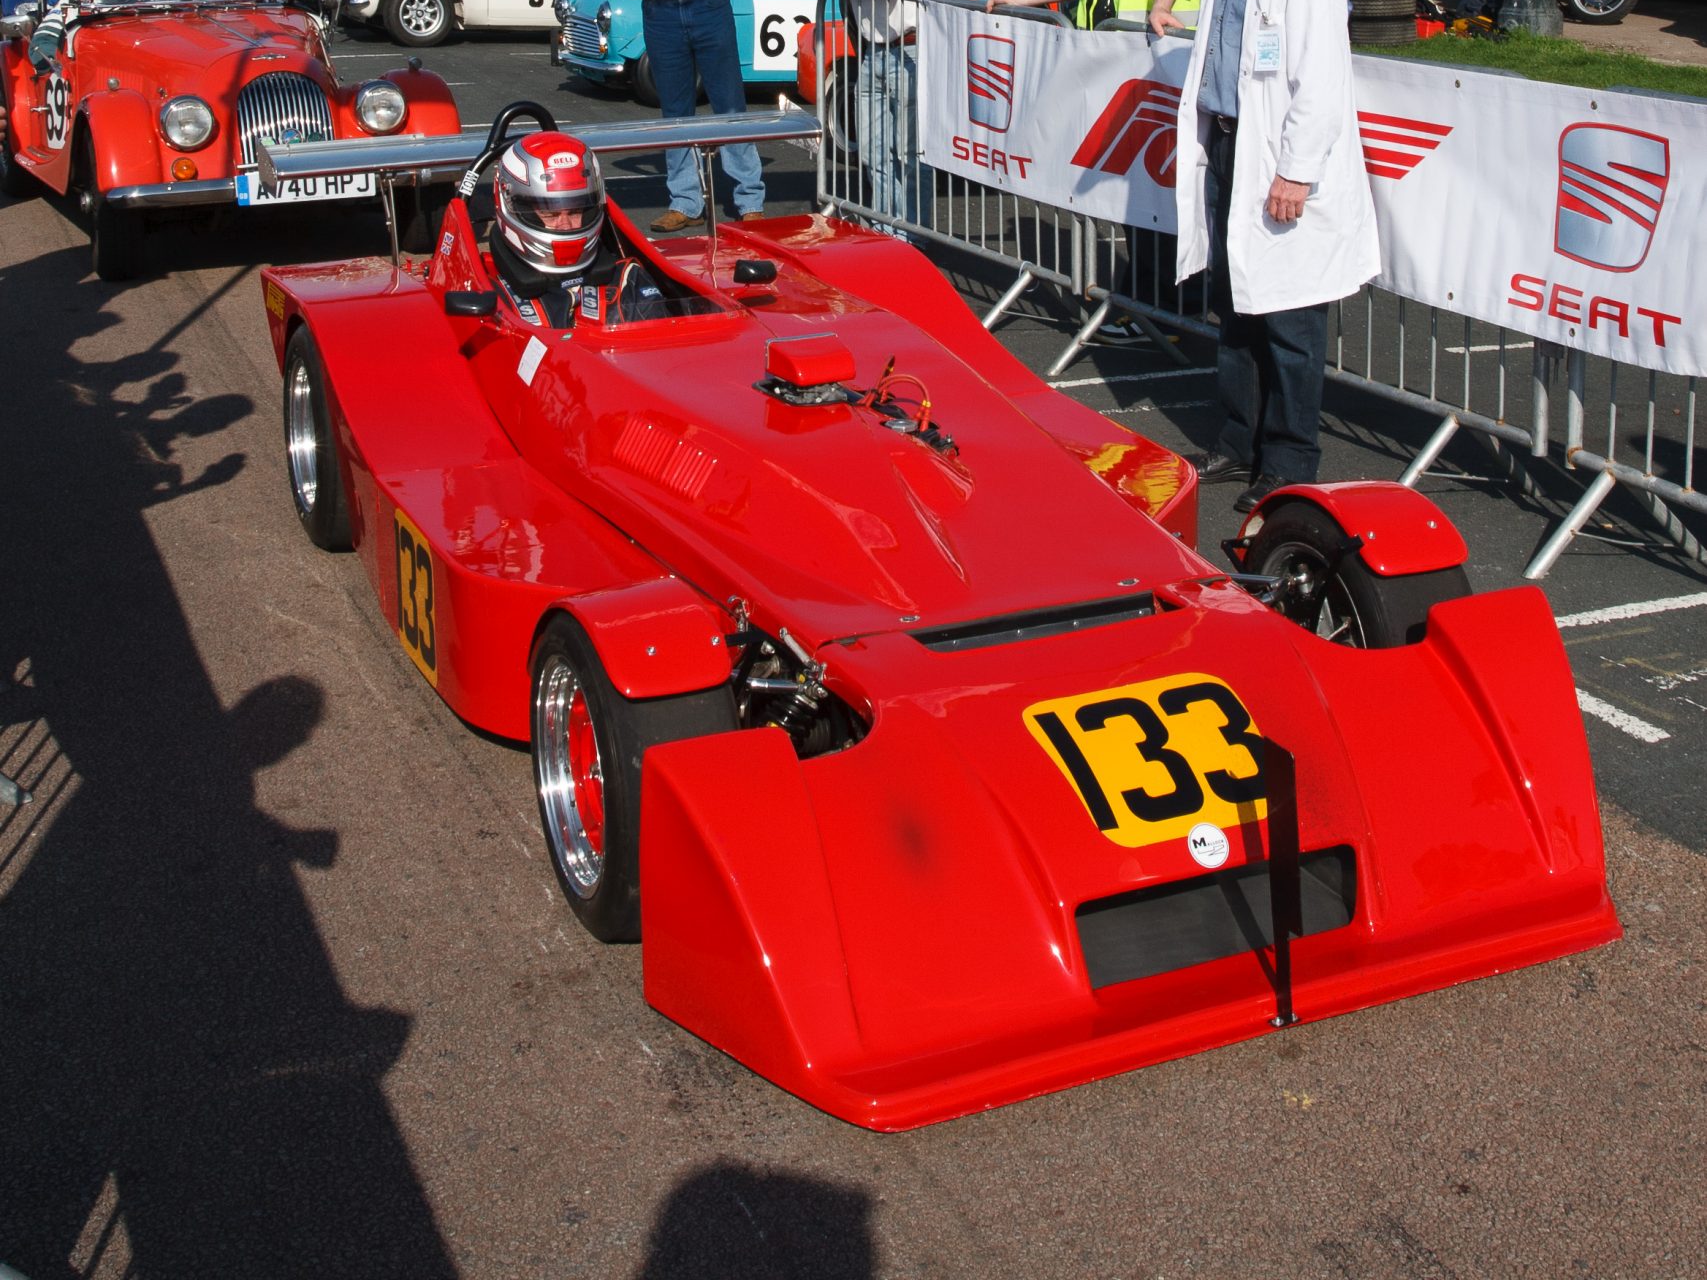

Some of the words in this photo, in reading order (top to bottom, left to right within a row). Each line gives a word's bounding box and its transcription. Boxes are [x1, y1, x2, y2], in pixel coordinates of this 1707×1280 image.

[553, 156, 576, 165] BELL
[952, 135, 1033, 180] SEAT
[325, 173, 370, 196] HPJ
[459, 170, 479, 196] TOW
[1507, 273, 1682, 348] SEAT
[394, 516, 436, 672] 133
[1033, 682, 1265, 832] 133
